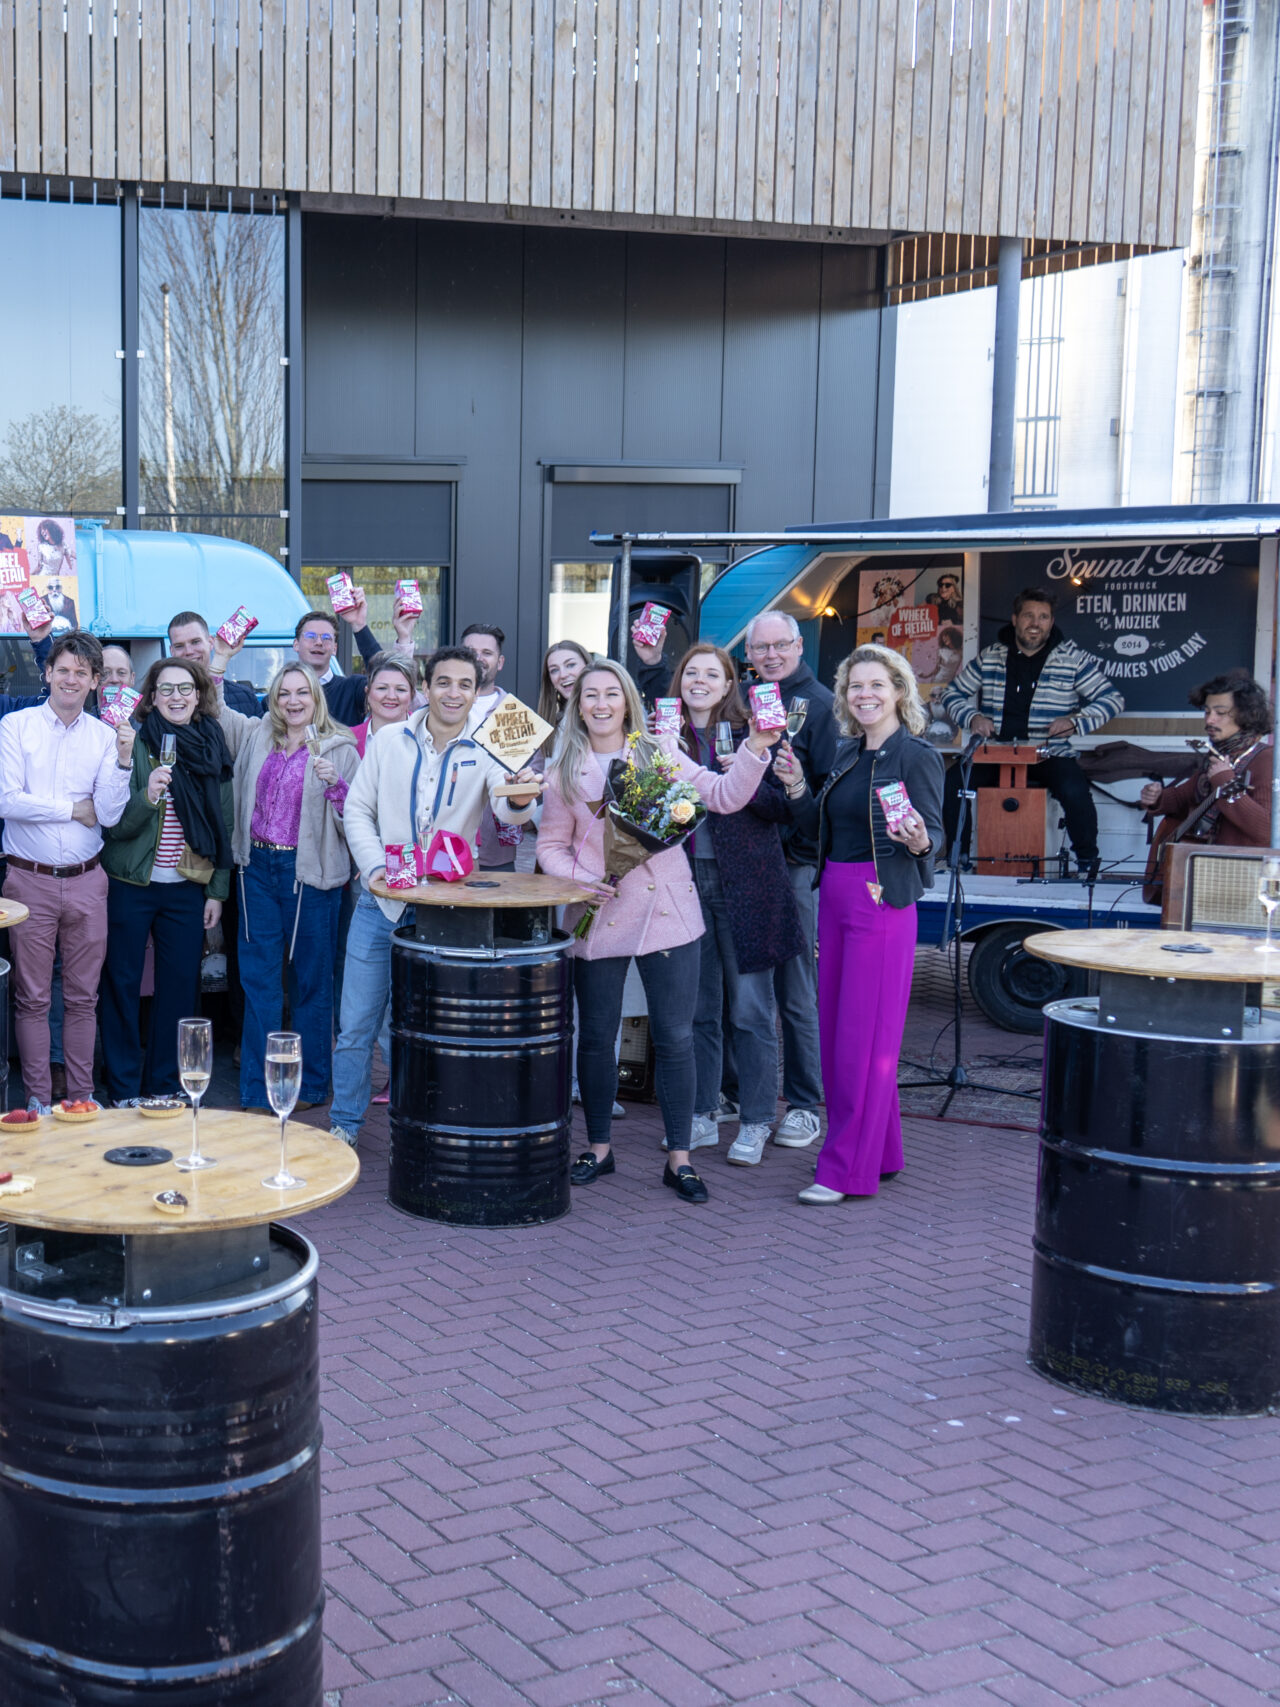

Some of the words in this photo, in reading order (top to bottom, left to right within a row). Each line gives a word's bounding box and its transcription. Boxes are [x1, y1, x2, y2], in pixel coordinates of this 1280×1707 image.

[1046, 545, 1151, 580] Sound
[1147, 542, 1225, 576] Trek
[1104, 581, 1158, 591] FOODTRUCK
[1076, 594, 1117, 615] ETEN,
[1122, 592, 1187, 613] DRINKEN
[898, 608, 930, 622] WHEEL
[1114, 615, 1160, 630] MUZIEK
[891, 623, 903, 637] OF
[904, 620, 936, 635] RETAIL
[1121, 640, 1142, 649] 2014
[1103, 660, 1148, 678] MAKES
[1149, 650, 1186, 674] YOUR
[1180, 631, 1208, 658] DAY
[494, 711, 530, 728] WHEEL
[489, 730, 502, 744] OF
[504, 723, 537, 741] RETAIL
